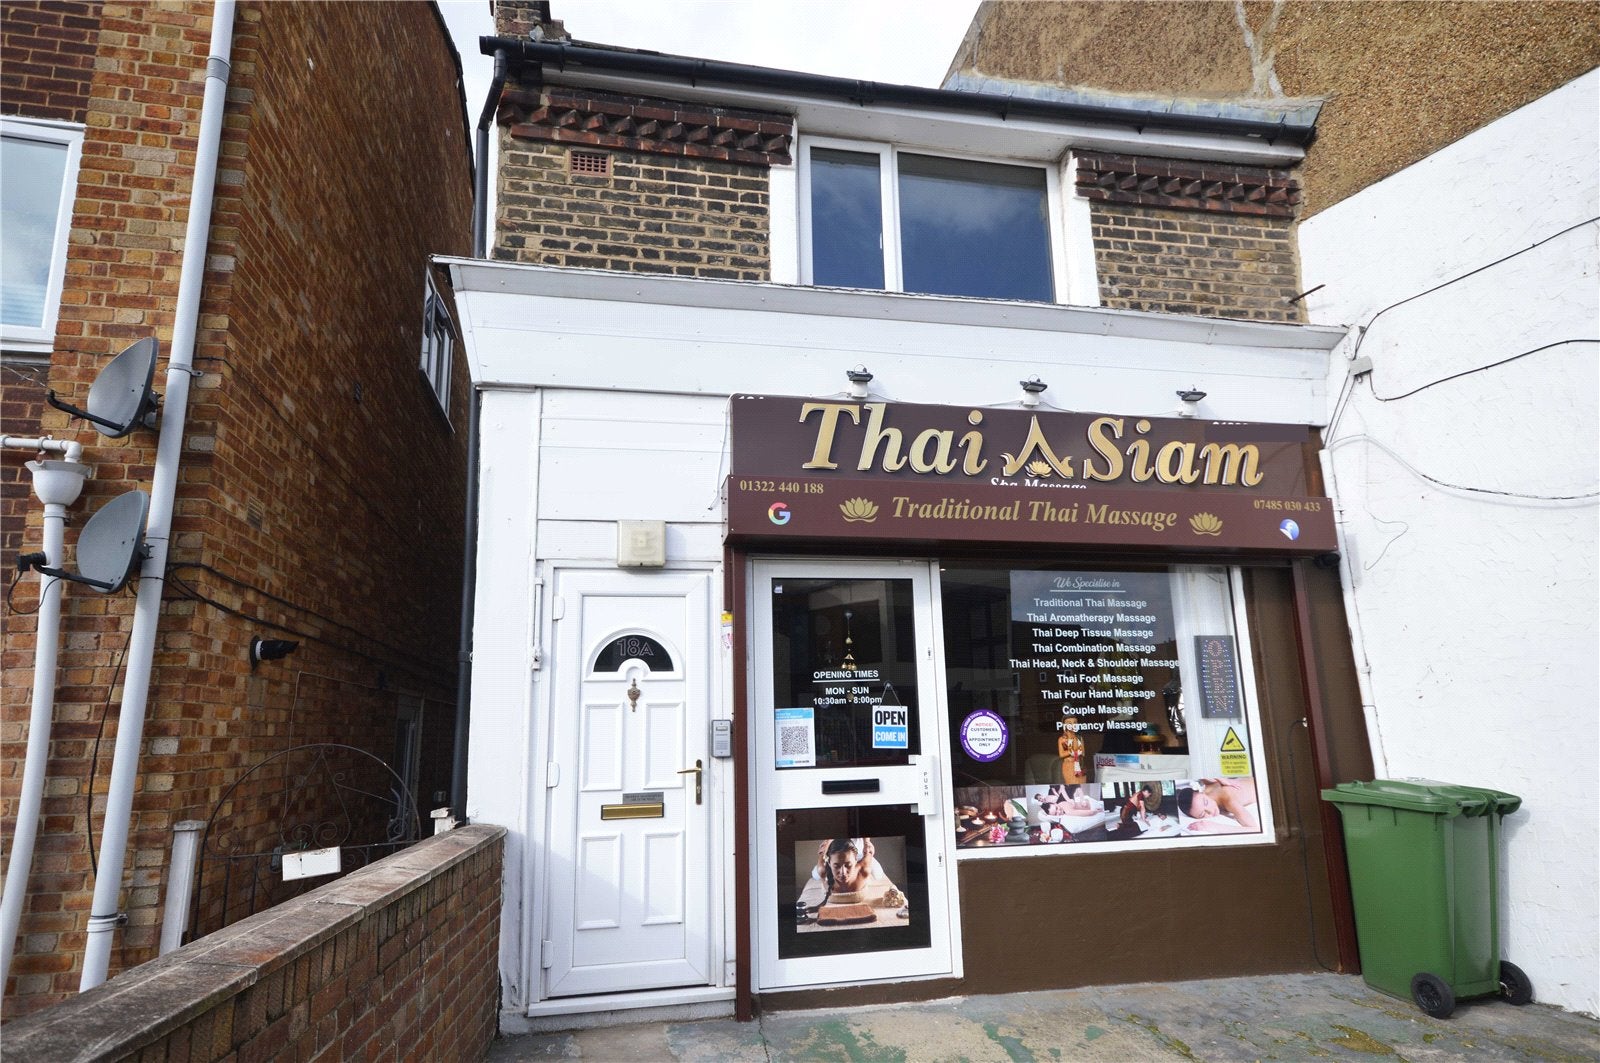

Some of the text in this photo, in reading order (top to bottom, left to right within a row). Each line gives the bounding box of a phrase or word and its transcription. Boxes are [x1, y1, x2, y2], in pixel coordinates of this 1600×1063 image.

[799, 402, 1264, 487] Thai Siam
[739, 480, 824, 495] 01322 440 188
[1253, 499, 1321, 513] 07485 030 433
[892, 496, 1178, 532] Traditional Thai Massage
[1053, 577, 1072, 588] We
[1033, 598, 1147, 609] Traditional Thai Massage
[1027, 613, 1156, 625] Thai Aromatherapy Massage
[1032, 628, 1153, 639] Thai Deep Tissue Massage
[616, 638, 655, 657] 18A
[1032, 643, 1156, 654] Thai Combination Massage
[1009, 658, 1180, 669] Thai Head, Neck & Shoulder Massage
[813, 669, 879, 679] OPENING TIMES
[1057, 673, 1144, 684] Thai Foot Massage
[825, 687, 845, 696] MON
[852, 686, 870, 695] SUN
[1041, 688, 1156, 699] Thai Four Hand Massage
[813, 697, 847, 706] 10:30am
[853, 695, 882, 705] 8:00pm
[1062, 705, 1139, 716] Couple Massage
[874, 710, 906, 726] OPEN
[1056, 720, 1148, 732] Pregnancy Massage
[875, 731, 906, 742] COME IN
